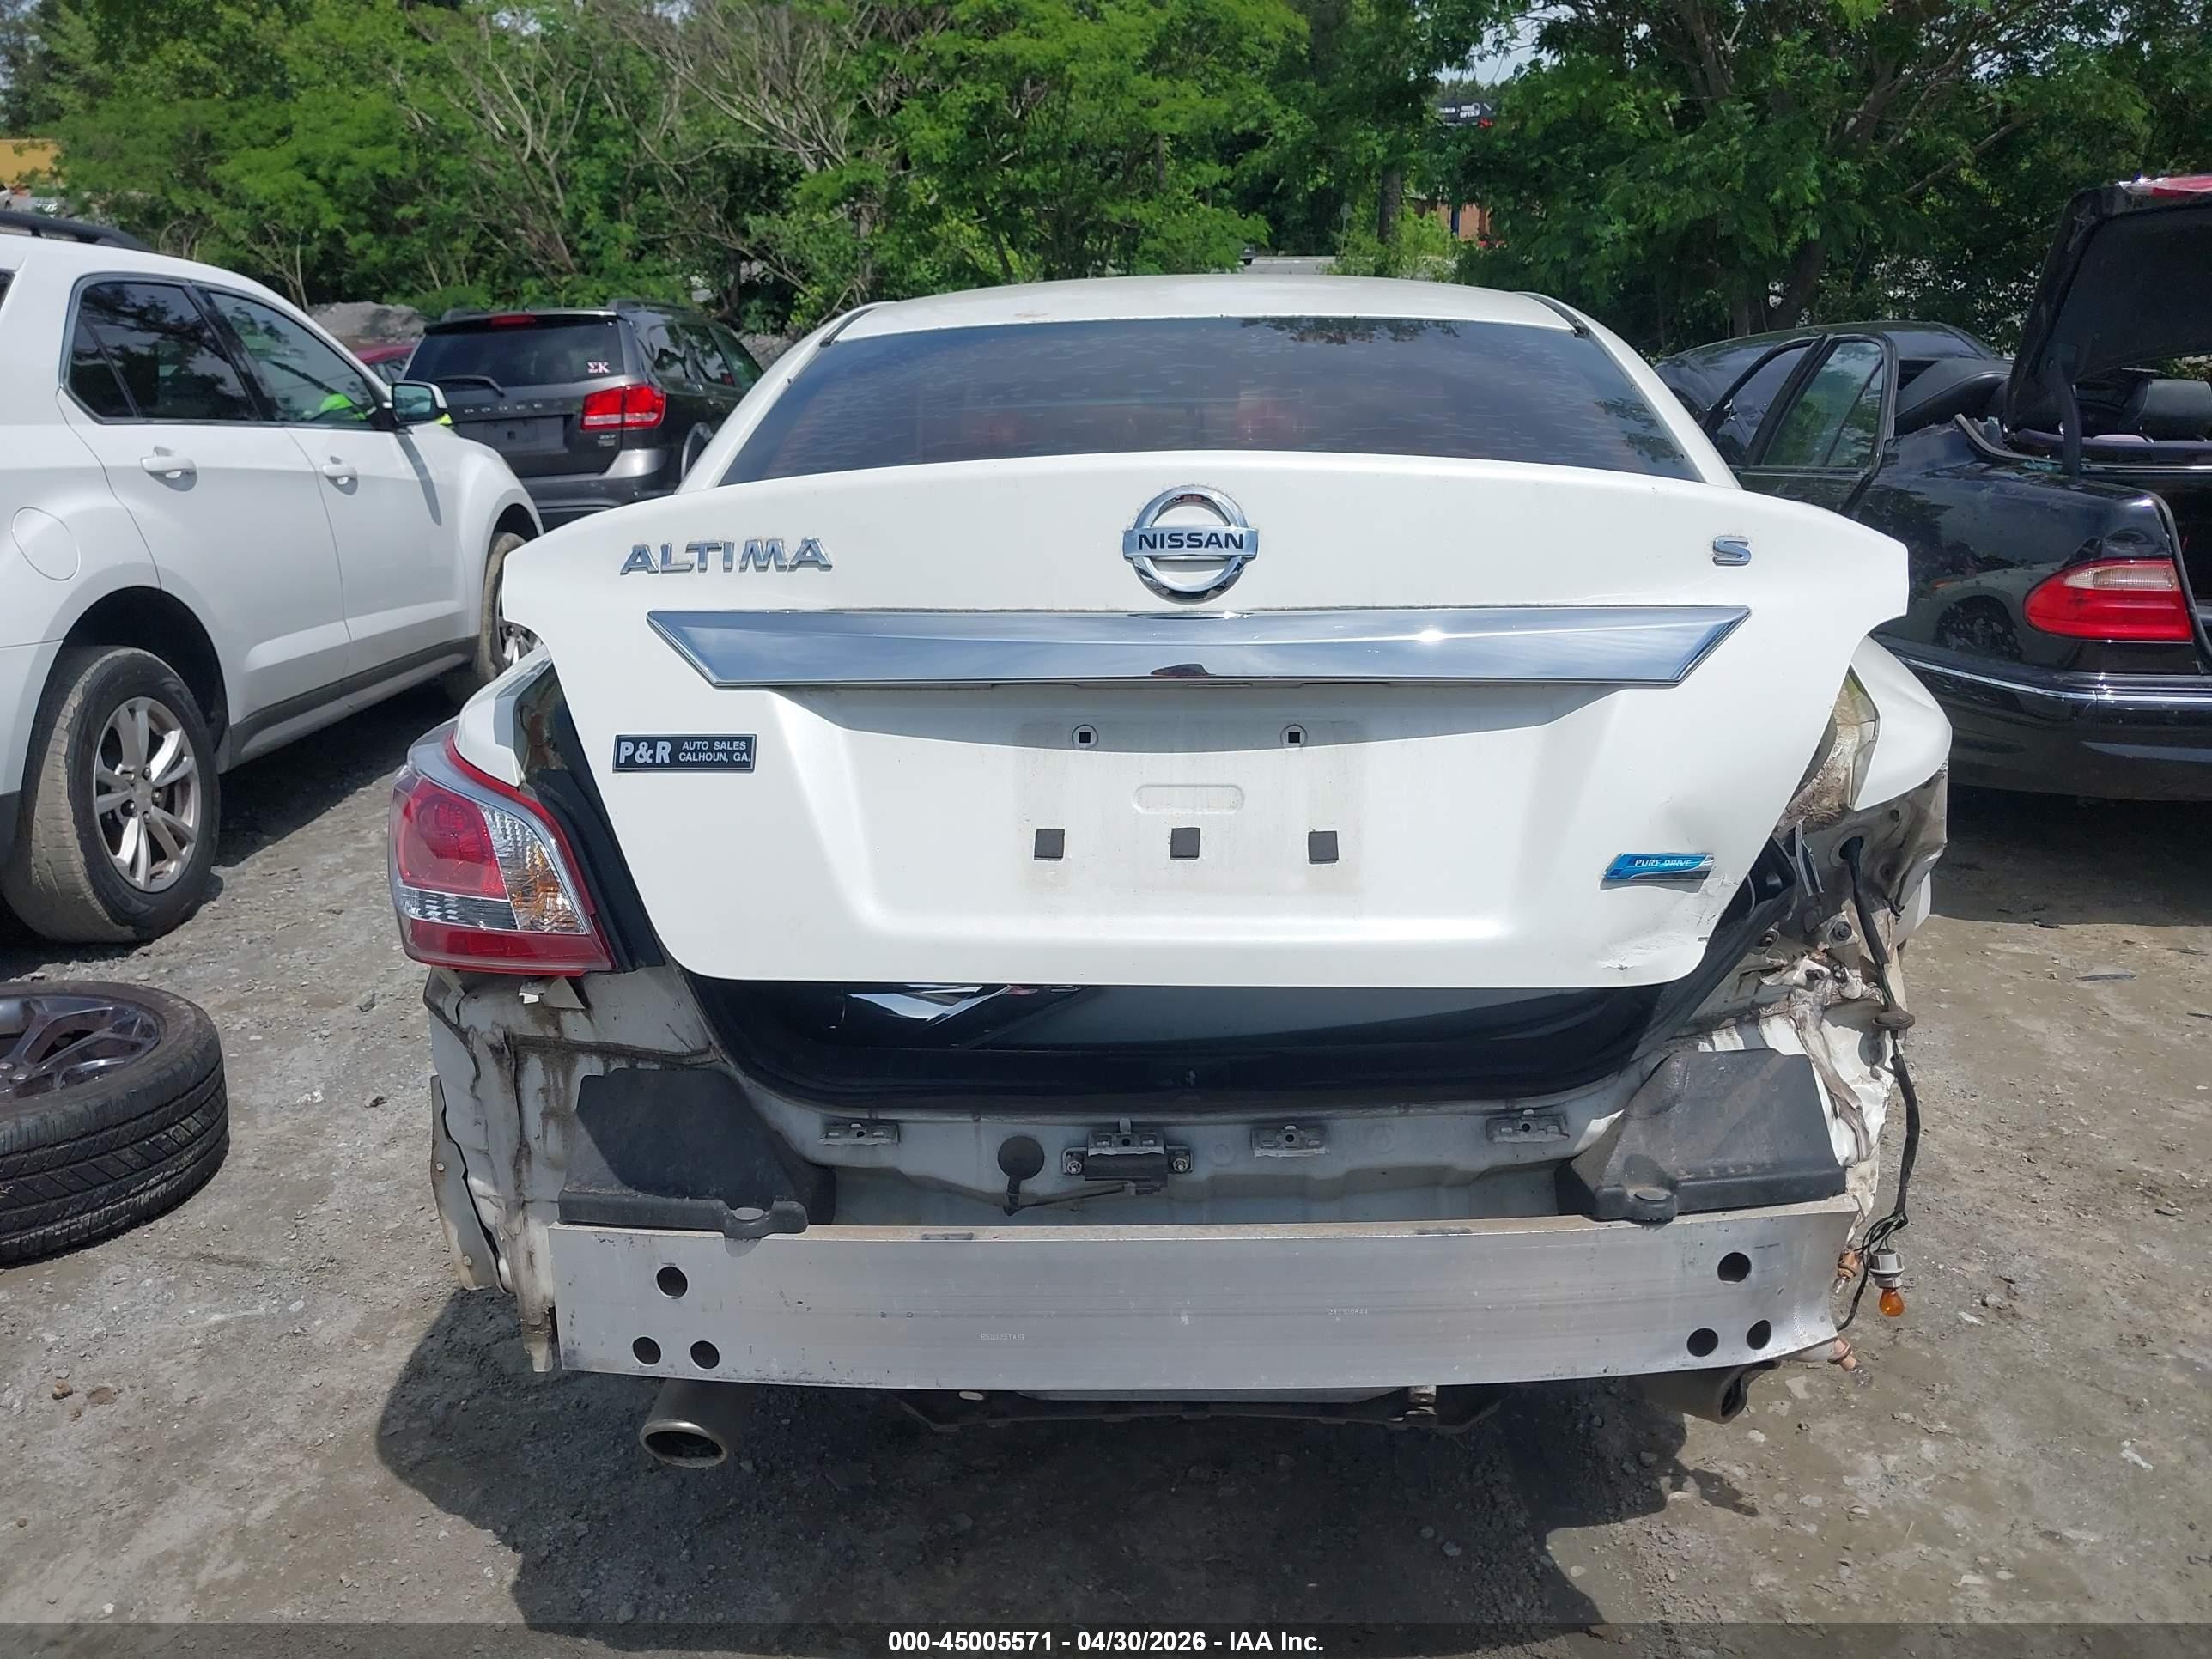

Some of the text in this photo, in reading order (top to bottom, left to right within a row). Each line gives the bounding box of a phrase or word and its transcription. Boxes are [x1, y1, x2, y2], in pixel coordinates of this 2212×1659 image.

[1138, 532, 1244, 550] NISSAN
[619, 537, 834, 576] ALTIMA
[1712, 535, 1752, 567] S
[618, 740, 672, 764] P&R
[682, 740, 747, 751] AUTO SALES
[678, 751, 751, 763] CALHOUN, GA.
[1634, 859, 1692, 867] PURE DRIVE
